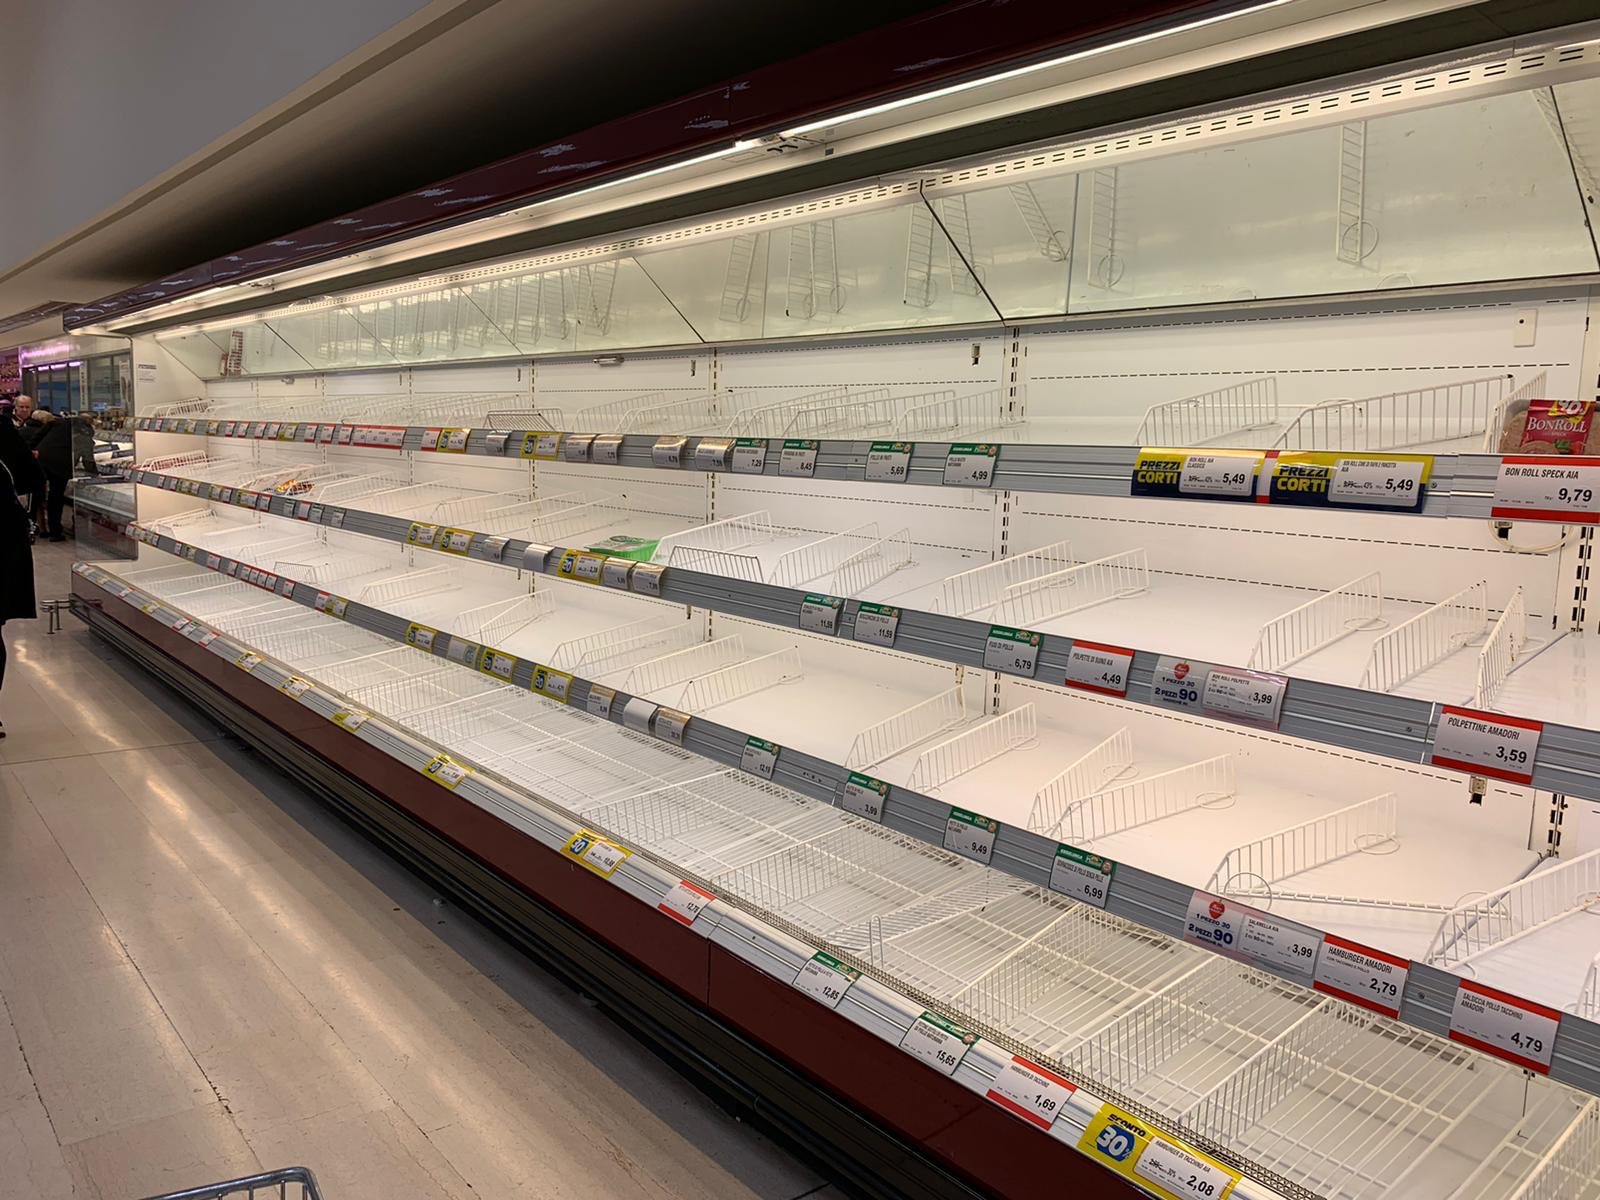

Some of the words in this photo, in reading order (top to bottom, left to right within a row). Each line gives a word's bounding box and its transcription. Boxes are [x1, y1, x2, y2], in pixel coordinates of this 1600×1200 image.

[1139, 460, 1181, 470] PREZZI
[1279, 466, 1329, 477] PREZZI
[971, 471, 988, 481] 4,99
[1137, 471, 1177, 484] CORTI
[1222, 473, 1245, 486] 5,49
[1505, 467, 1520, 476] BON
[1521, 468, 1539, 478] ROLL
[1541, 469, 1564, 479] SPECK
[1566, 470, 1579, 480] AIA
[1276, 478, 1327, 492] CORTI
[1385, 478, 1413, 492] 5,49
[1558, 488, 1592, 503] 9,79
[1014, 659, 1032, 670] 6,79
[1101, 672, 1121, 685] 4,49
[1166, 678, 1185, 686] PEZZO
[1154, 687, 1161, 695] 2
[1161, 689, 1178, 698] PEZZI
[1179, 688, 1198, 702] 90
[1252, 692, 1273, 704] 3,99
[1448, 717, 1487, 733] POLPETTINE
[1487, 725, 1520, 740] AMADORI
[1495, 745, 1527, 763] 3,59
[971, 842, 988, 855] 9,49
[1084, 884, 1103, 899] 6,99
[1200, 914, 1221, 926] PEZZO
[1188, 923, 1195, 932] 2
[1195, 925, 1213, 938] PEZZI
[1213, 929, 1233, 945] 90
[1292, 944, 1313, 958] 3,99
[1328, 946, 1364, 965] HAMBURGER
[1364, 959, 1393, 974] AMADORI
[1369, 978, 1397, 996] 2,79
[1461, 1000, 1485, 1014] AMADORI
[1463, 993, 1485, 1006] SALSICCIA
[1485, 1000, 1501, 1012] POLLO
[1501, 1006, 1524, 1020] TACCHINO
[1511, 1032, 1543, 1053] 4,79
[936, 1050, 956, 1066] 15,65
[1034, 1094, 1056, 1111] 1,69
[1107, 1113, 1146, 1137] SCONTO
[1183, 1154, 1204, 1169] TACCHINO
[1186, 1175, 1215, 1196] 2,08
